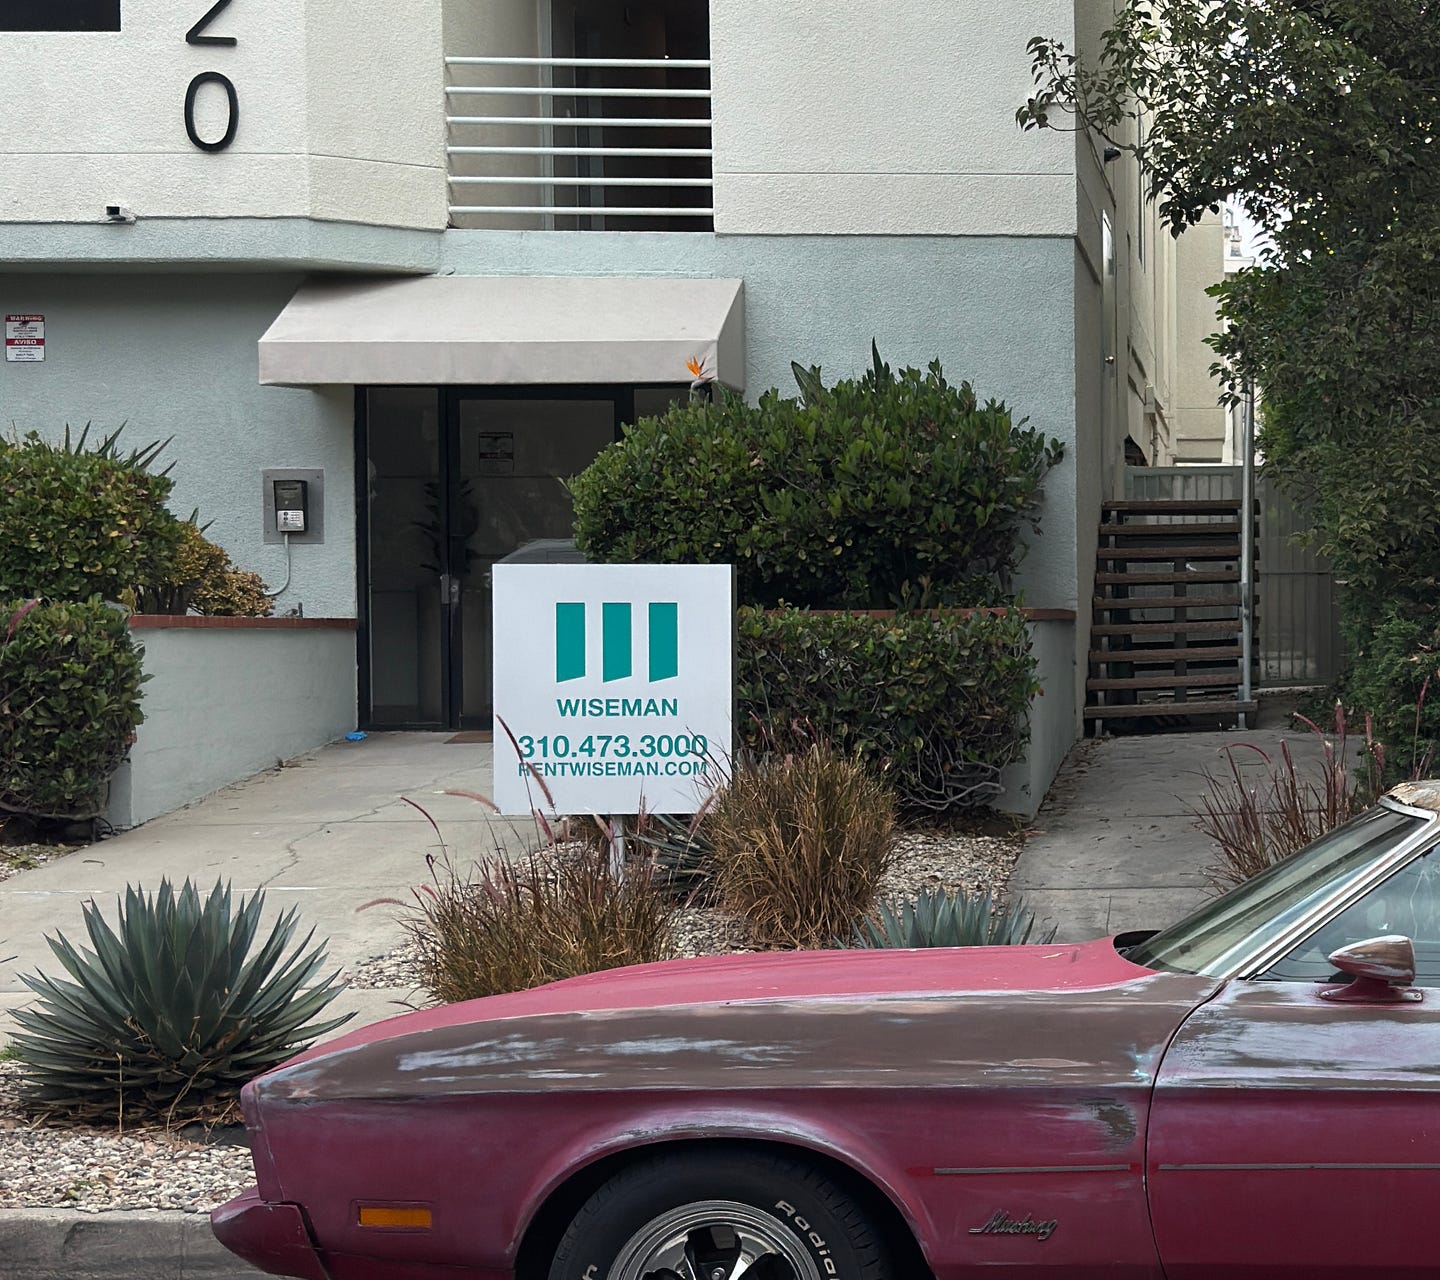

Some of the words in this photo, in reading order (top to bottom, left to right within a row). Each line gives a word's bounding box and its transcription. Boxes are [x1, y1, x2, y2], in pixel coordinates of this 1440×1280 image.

[556, 698, 678, 717] WISEMAN
[518, 734, 708, 758] 310.473.3000
[518, 761, 707, 777] RENTWISEMAN.COM
[968, 1208, 1057, 1241] Mustang
